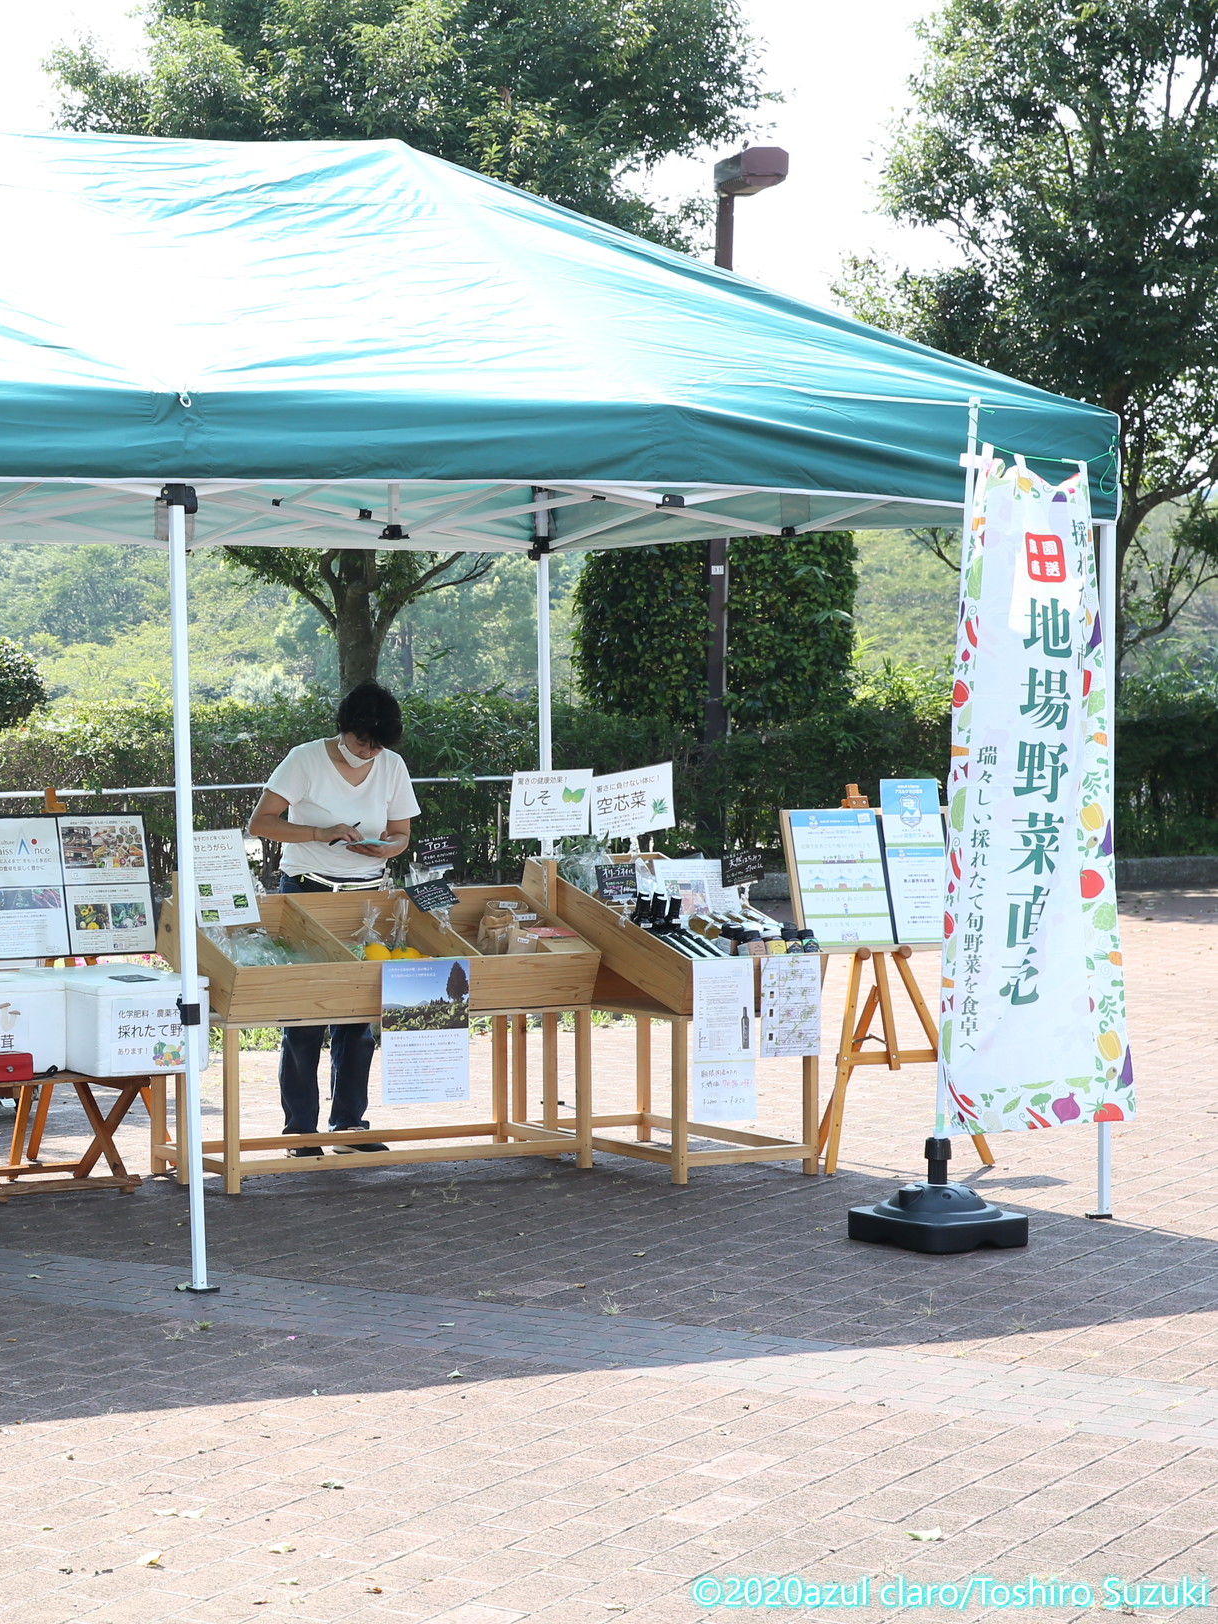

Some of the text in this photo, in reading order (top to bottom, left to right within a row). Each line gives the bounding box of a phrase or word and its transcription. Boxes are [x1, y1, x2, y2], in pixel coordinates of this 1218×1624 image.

[523, 790, 551, 806] しそ
[596, 790, 647, 816] 空芯菜
[959, 746, 998, 1052] 瑞々しい採れたて旬野菜を食卓へ
[118, 1008, 180, 1019] 化学肥料・農薬不
[118, 1023, 185, 1039] 採れたて野
